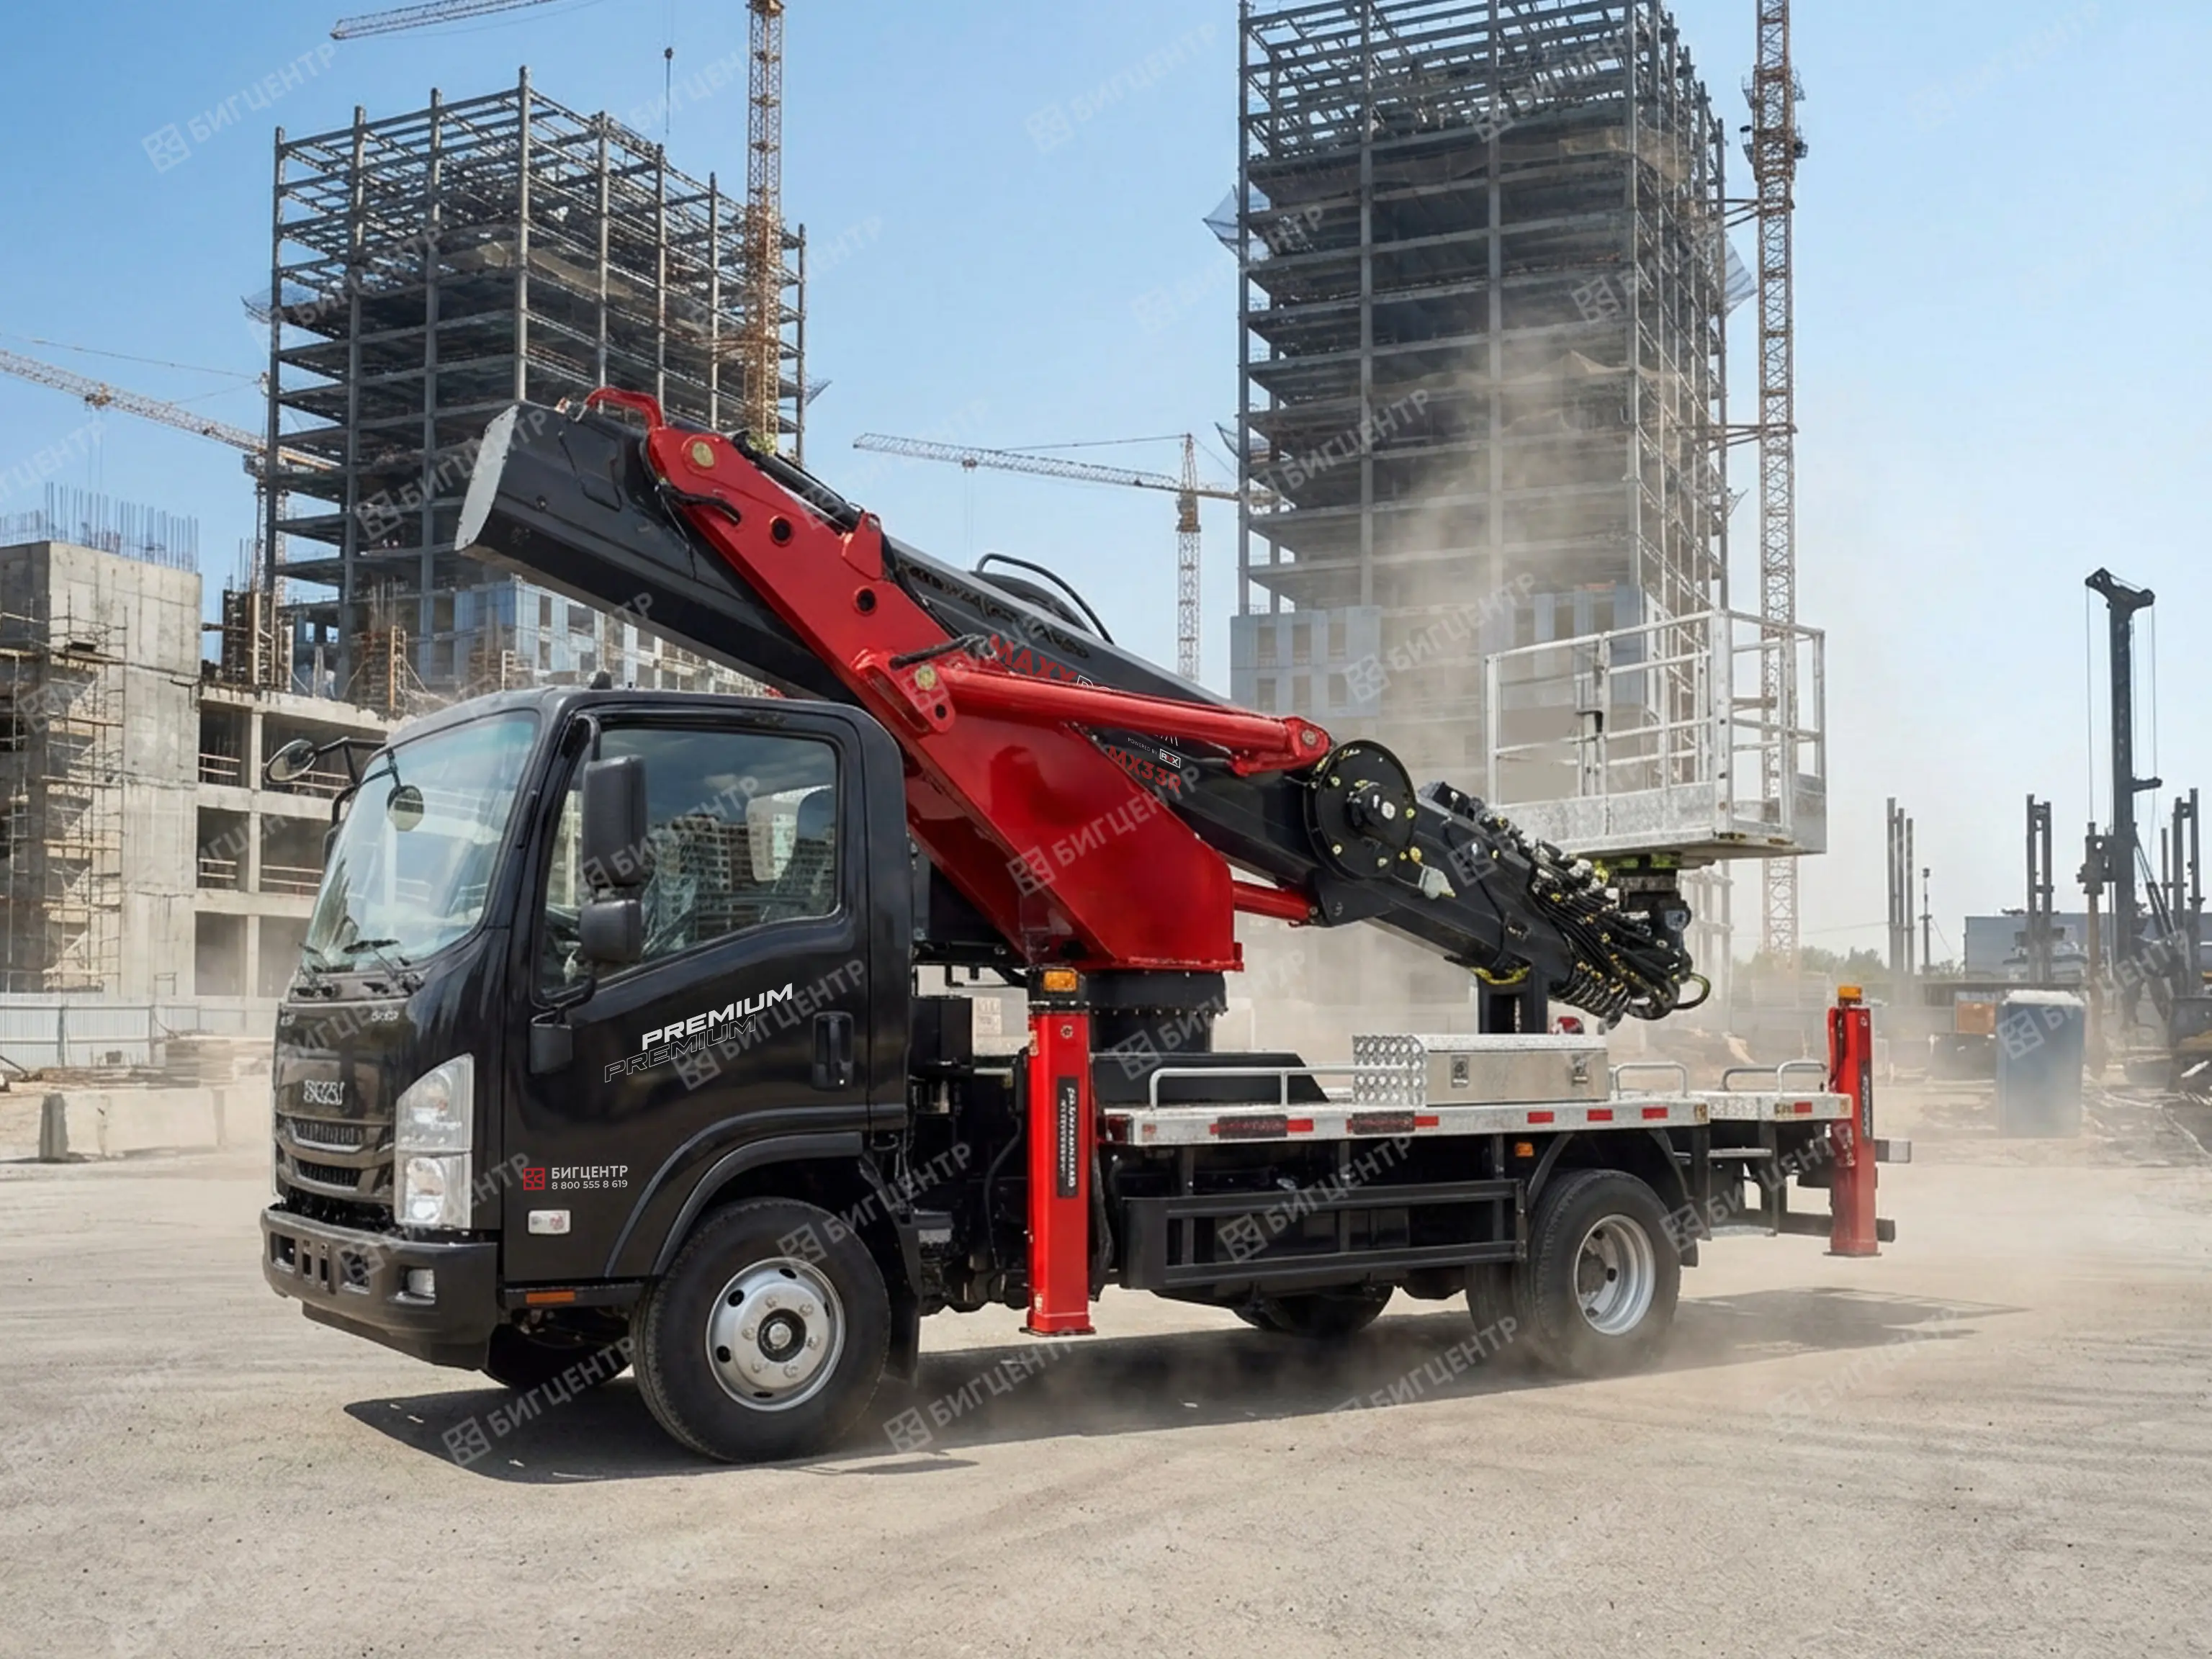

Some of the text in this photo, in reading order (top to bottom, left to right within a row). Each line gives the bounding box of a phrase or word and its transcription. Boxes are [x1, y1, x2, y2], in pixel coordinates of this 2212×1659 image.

[1109, 745, 1182, 794] MX33R
[1128, 737, 1151, 752] POWERED
[1161, 752, 1179, 765] RMX
[642, 983, 793, 1051] PREMIUM
[605, 1014, 756, 1083] PREMIUM
[552, 1165, 629, 1180] БИГЦЕНТР
[560, 1181, 580, 1190] 800
[583, 1180, 601, 1189] 555
[611, 1179, 628, 1188] 619
